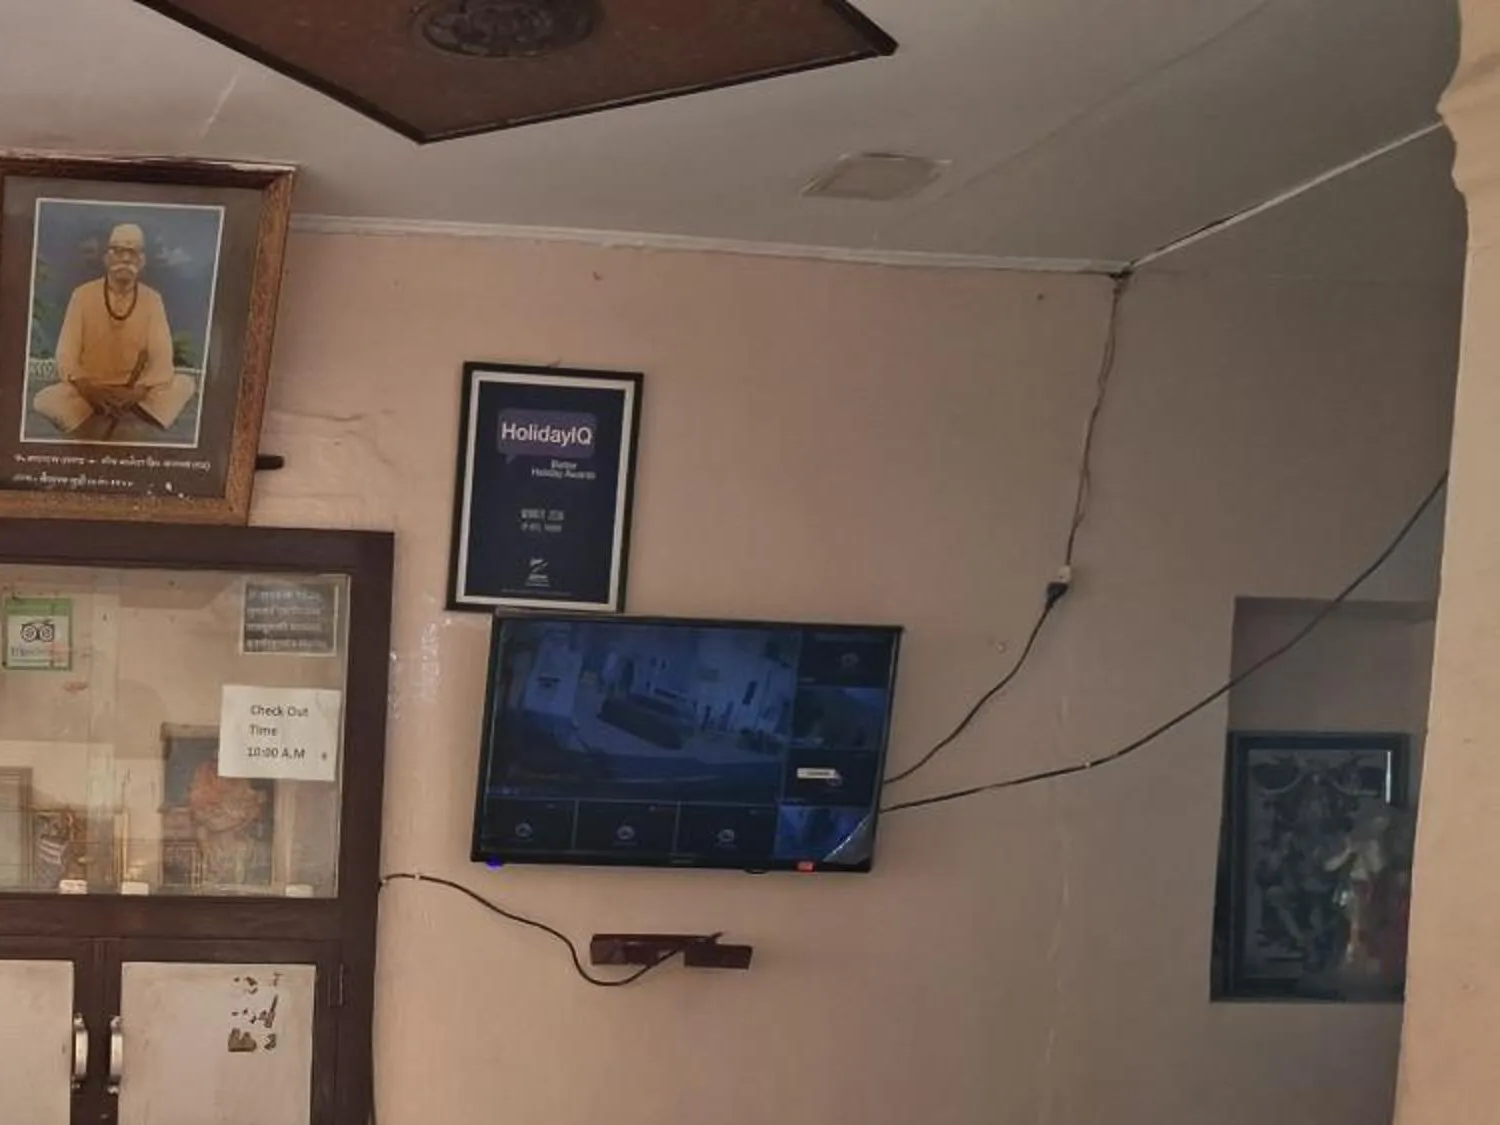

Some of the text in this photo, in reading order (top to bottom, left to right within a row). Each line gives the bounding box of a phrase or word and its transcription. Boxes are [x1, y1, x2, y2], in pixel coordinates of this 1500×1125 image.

[501, 421, 593, 447] HolidayIQ
[250, 704, 309, 718] Check Out
[249, 724, 278, 737] Time
[247, 746, 279, 759] 10:00
